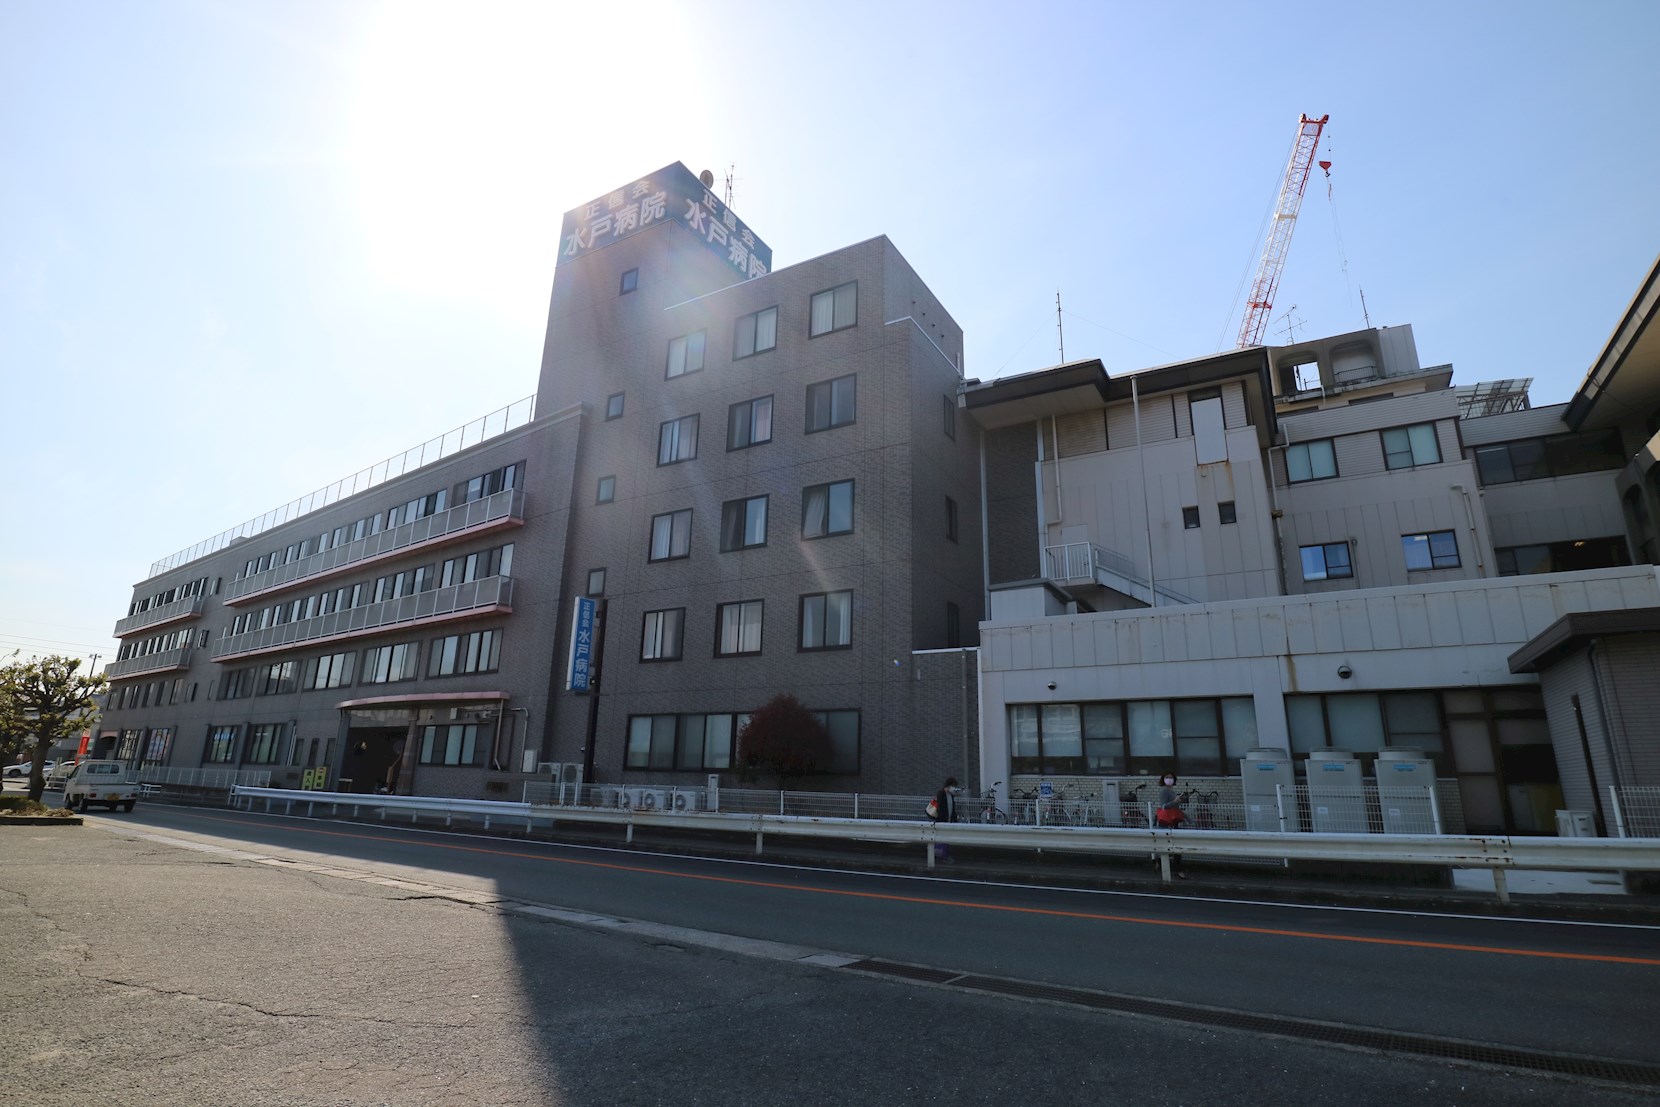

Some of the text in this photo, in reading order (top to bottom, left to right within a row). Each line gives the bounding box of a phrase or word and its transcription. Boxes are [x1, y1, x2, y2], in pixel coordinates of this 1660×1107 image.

[563, 191, 668, 256] 水戸病院
[584, 180, 650, 221] 正信会
[702, 189, 756, 250] 正信会
[683, 198, 768, 279] 水戸病院
[573, 629, 591, 688] 水戸病院
